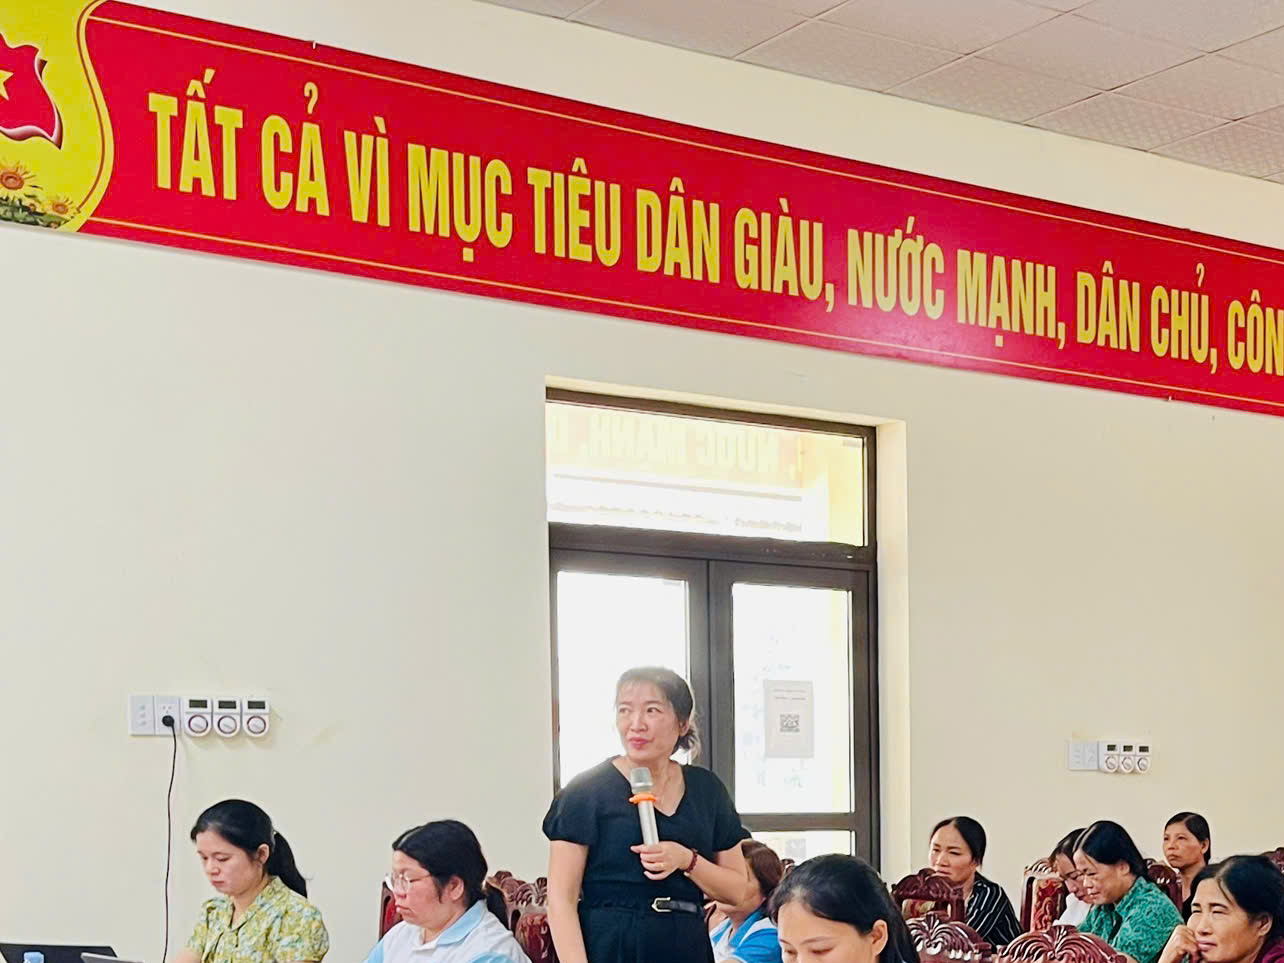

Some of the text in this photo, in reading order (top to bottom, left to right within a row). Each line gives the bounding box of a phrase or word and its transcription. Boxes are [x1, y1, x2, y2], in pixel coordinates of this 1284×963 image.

[148, 69, 244, 201] TẤT
[262, 82, 331, 217] CẢ
[343, 116, 390, 228] VÌ
[407, 144, 513, 263] MỤC
[527, 157, 621, 270] TIÊU
[636, 178, 720, 284] DÂN
[734, 200, 834, 313] GIÀU,
[847, 217, 944, 320] NƯỚC
[958, 250, 1066, 349] MẠNH,
[1077, 263, 1140, 354] DÂN
[1151, 263, 1217, 374] CHỦ,
